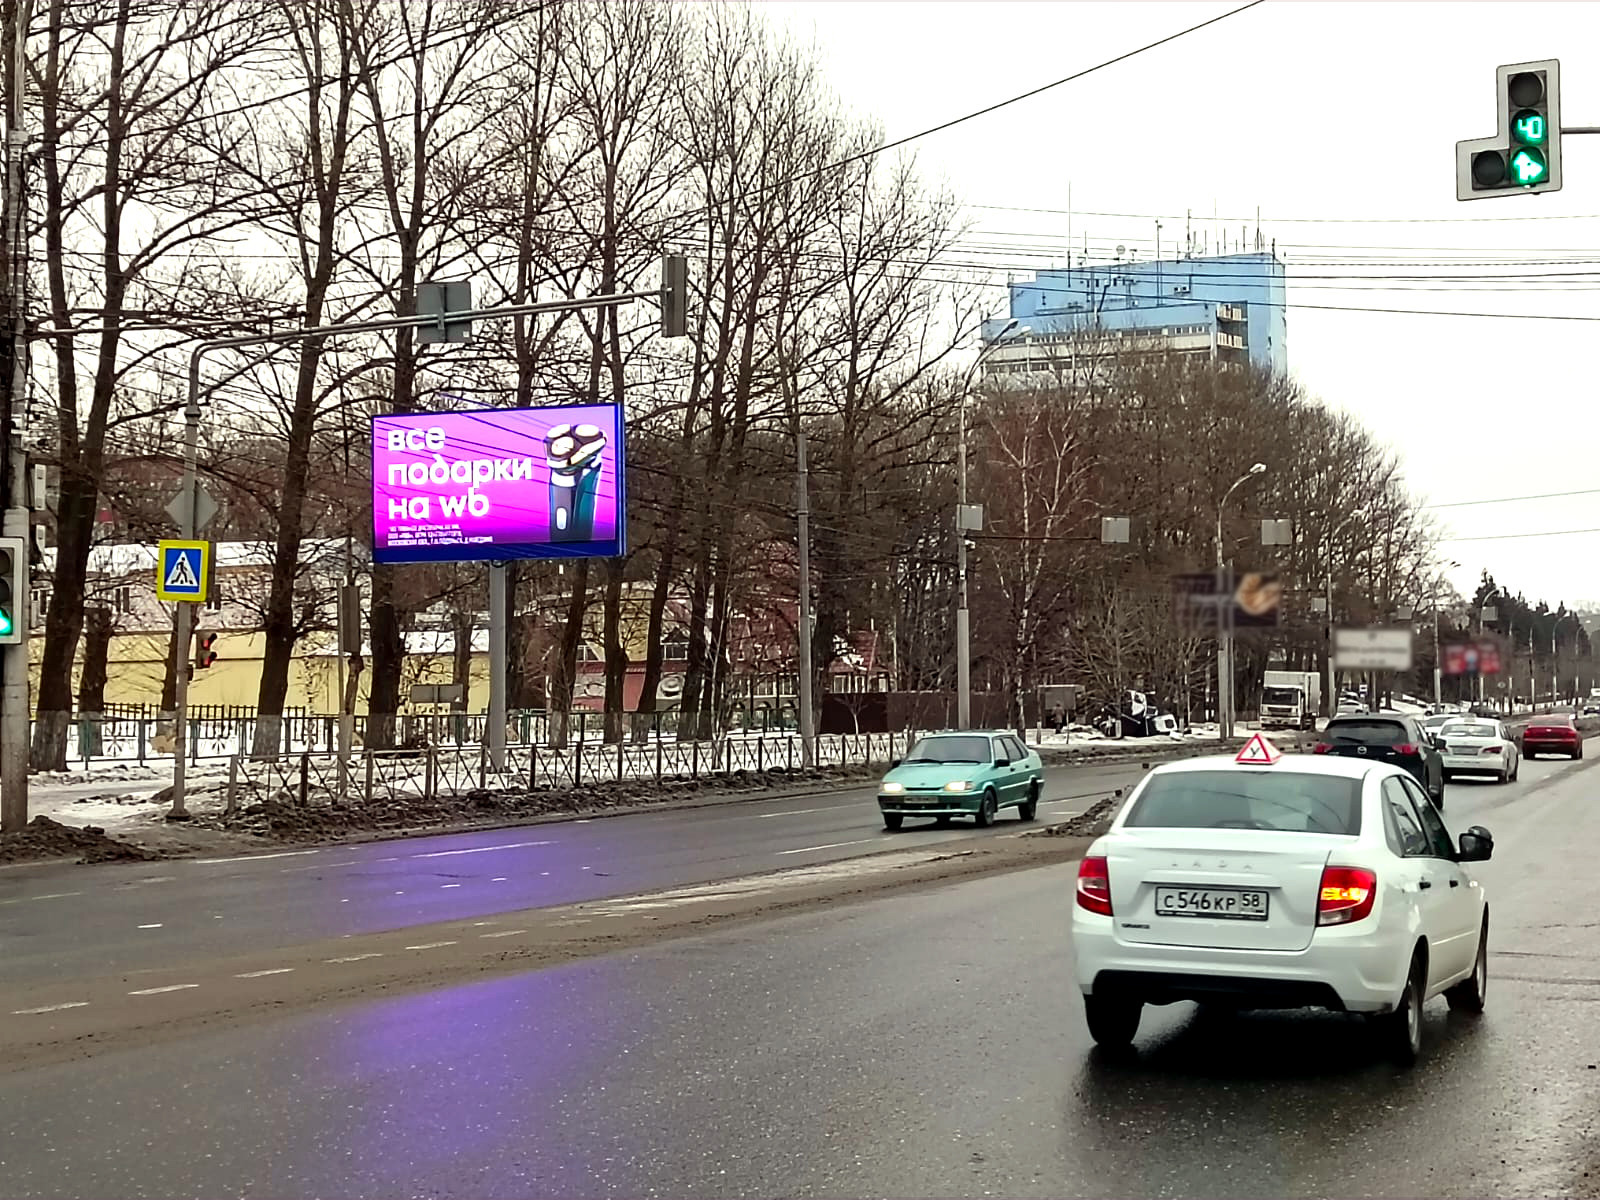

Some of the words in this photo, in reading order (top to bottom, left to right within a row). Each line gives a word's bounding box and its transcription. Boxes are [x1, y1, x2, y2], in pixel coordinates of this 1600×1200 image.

[388, 426, 446, 452] все
[388, 454, 532, 488] подарки
[388, 495, 430, 520] на
[439, 487, 490, 518] wb
